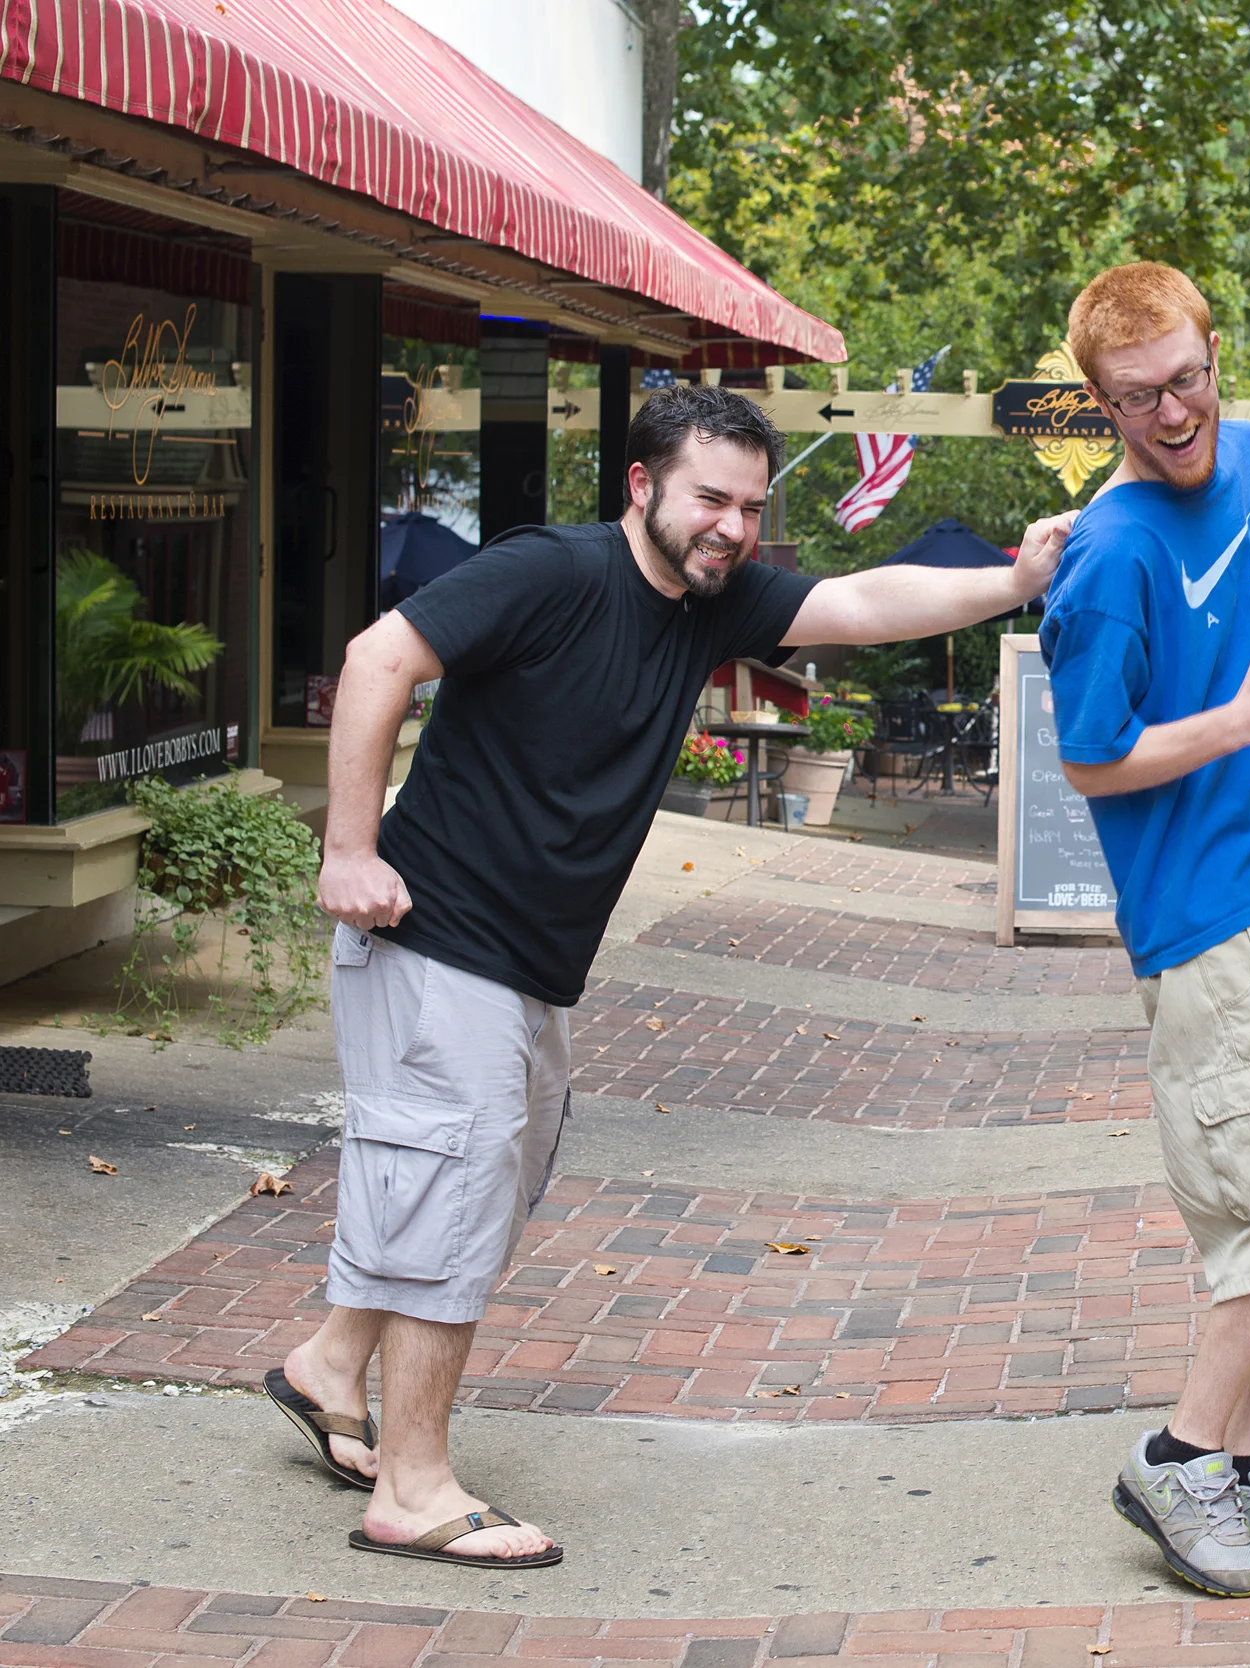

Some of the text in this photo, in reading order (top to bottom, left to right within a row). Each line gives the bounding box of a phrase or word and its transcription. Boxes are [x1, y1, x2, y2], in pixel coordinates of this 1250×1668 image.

[1011, 426, 1097, 436] RESTAURANT
[89, 494, 182, 520] RESTAURANT
[203, 494, 225, 518] BAR
[1207, 611, 1220, 629] A
[97, 727, 221, 783] WWW.ILOVEBOBBYS.COM
[1055, 883, 1102, 892] FOR THE
[1048, 892, 1075, 907] LOVE
[1081, 893, 1108, 907] BEER
